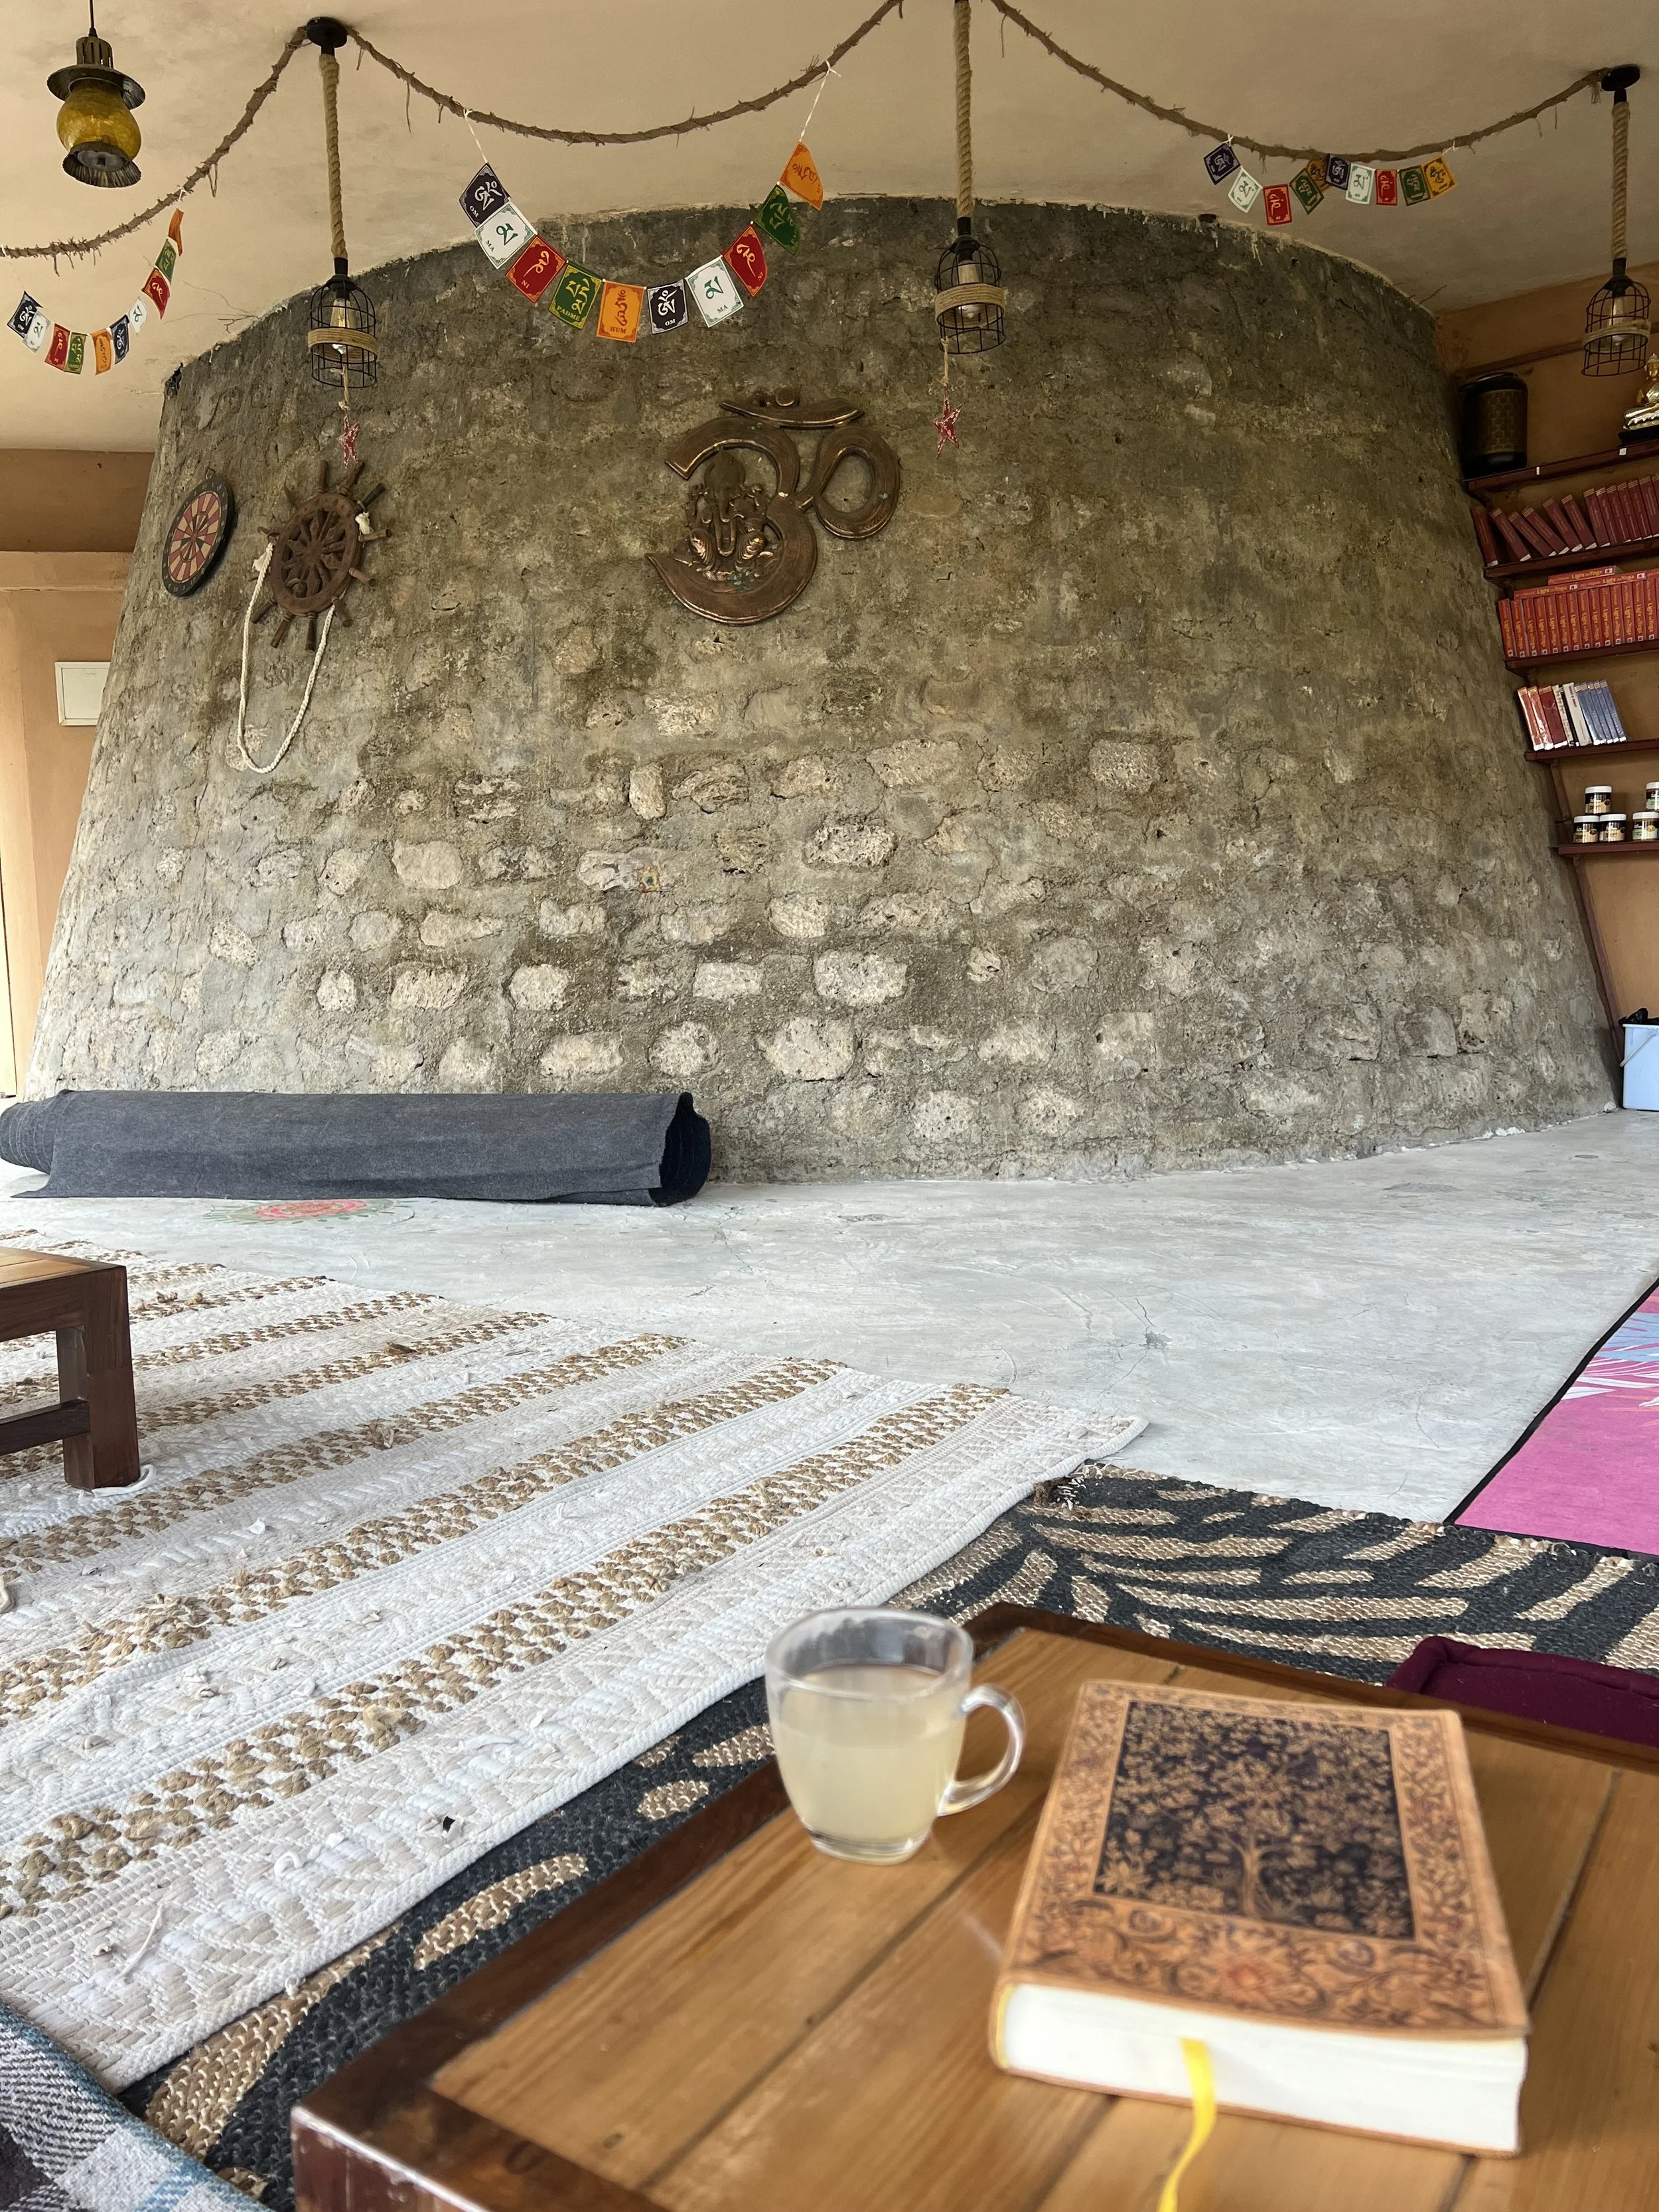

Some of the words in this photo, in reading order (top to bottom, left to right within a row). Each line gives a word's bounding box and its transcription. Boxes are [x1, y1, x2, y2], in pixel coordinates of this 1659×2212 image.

[469, 206, 479, 218] OM
[486, 240, 494, 252] MA
[521, 279, 530, 289] NI
[556, 305, 581, 321] PADME
[717, 305, 729, 314] MA
[610, 326, 627, 334] HUM
